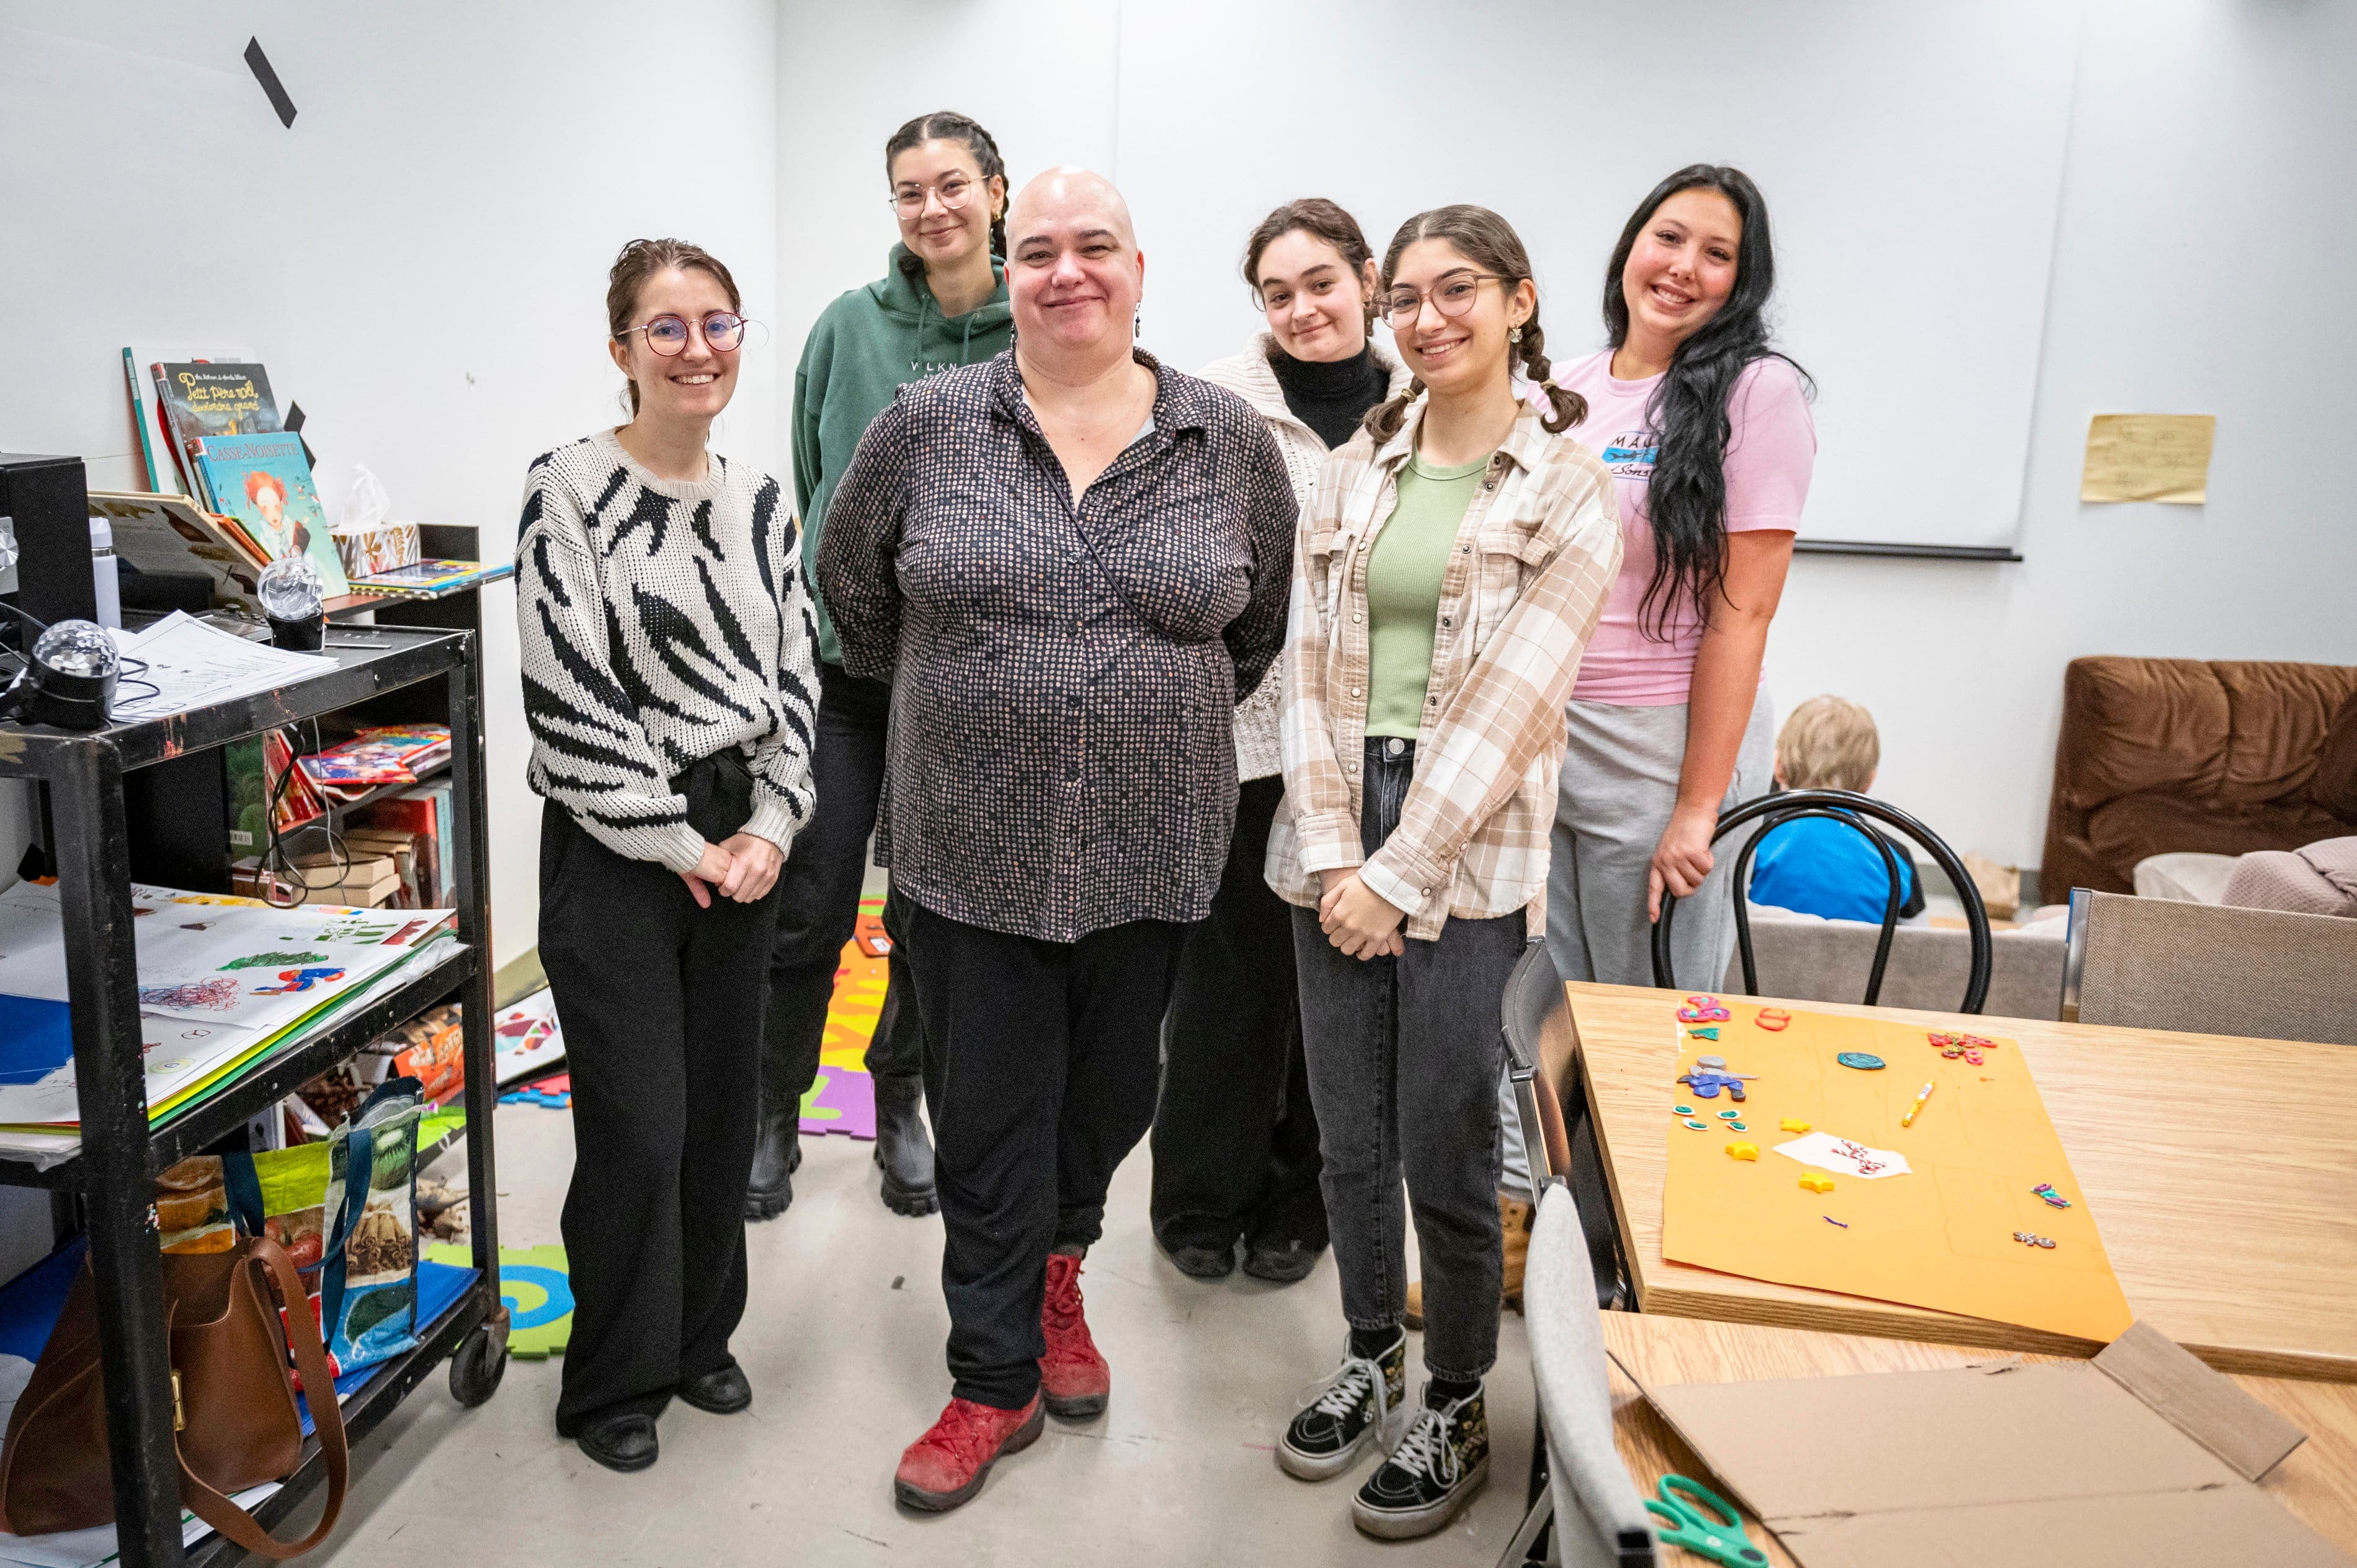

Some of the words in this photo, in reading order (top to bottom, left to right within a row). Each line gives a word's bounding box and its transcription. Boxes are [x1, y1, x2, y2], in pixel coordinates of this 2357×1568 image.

[179, 372, 210, 401] Petit
[234, 401, 260, 420] grand
[207, 443, 300, 462] CASSE-NOISETTE
[1611, 464, 1648, 476] Sons
